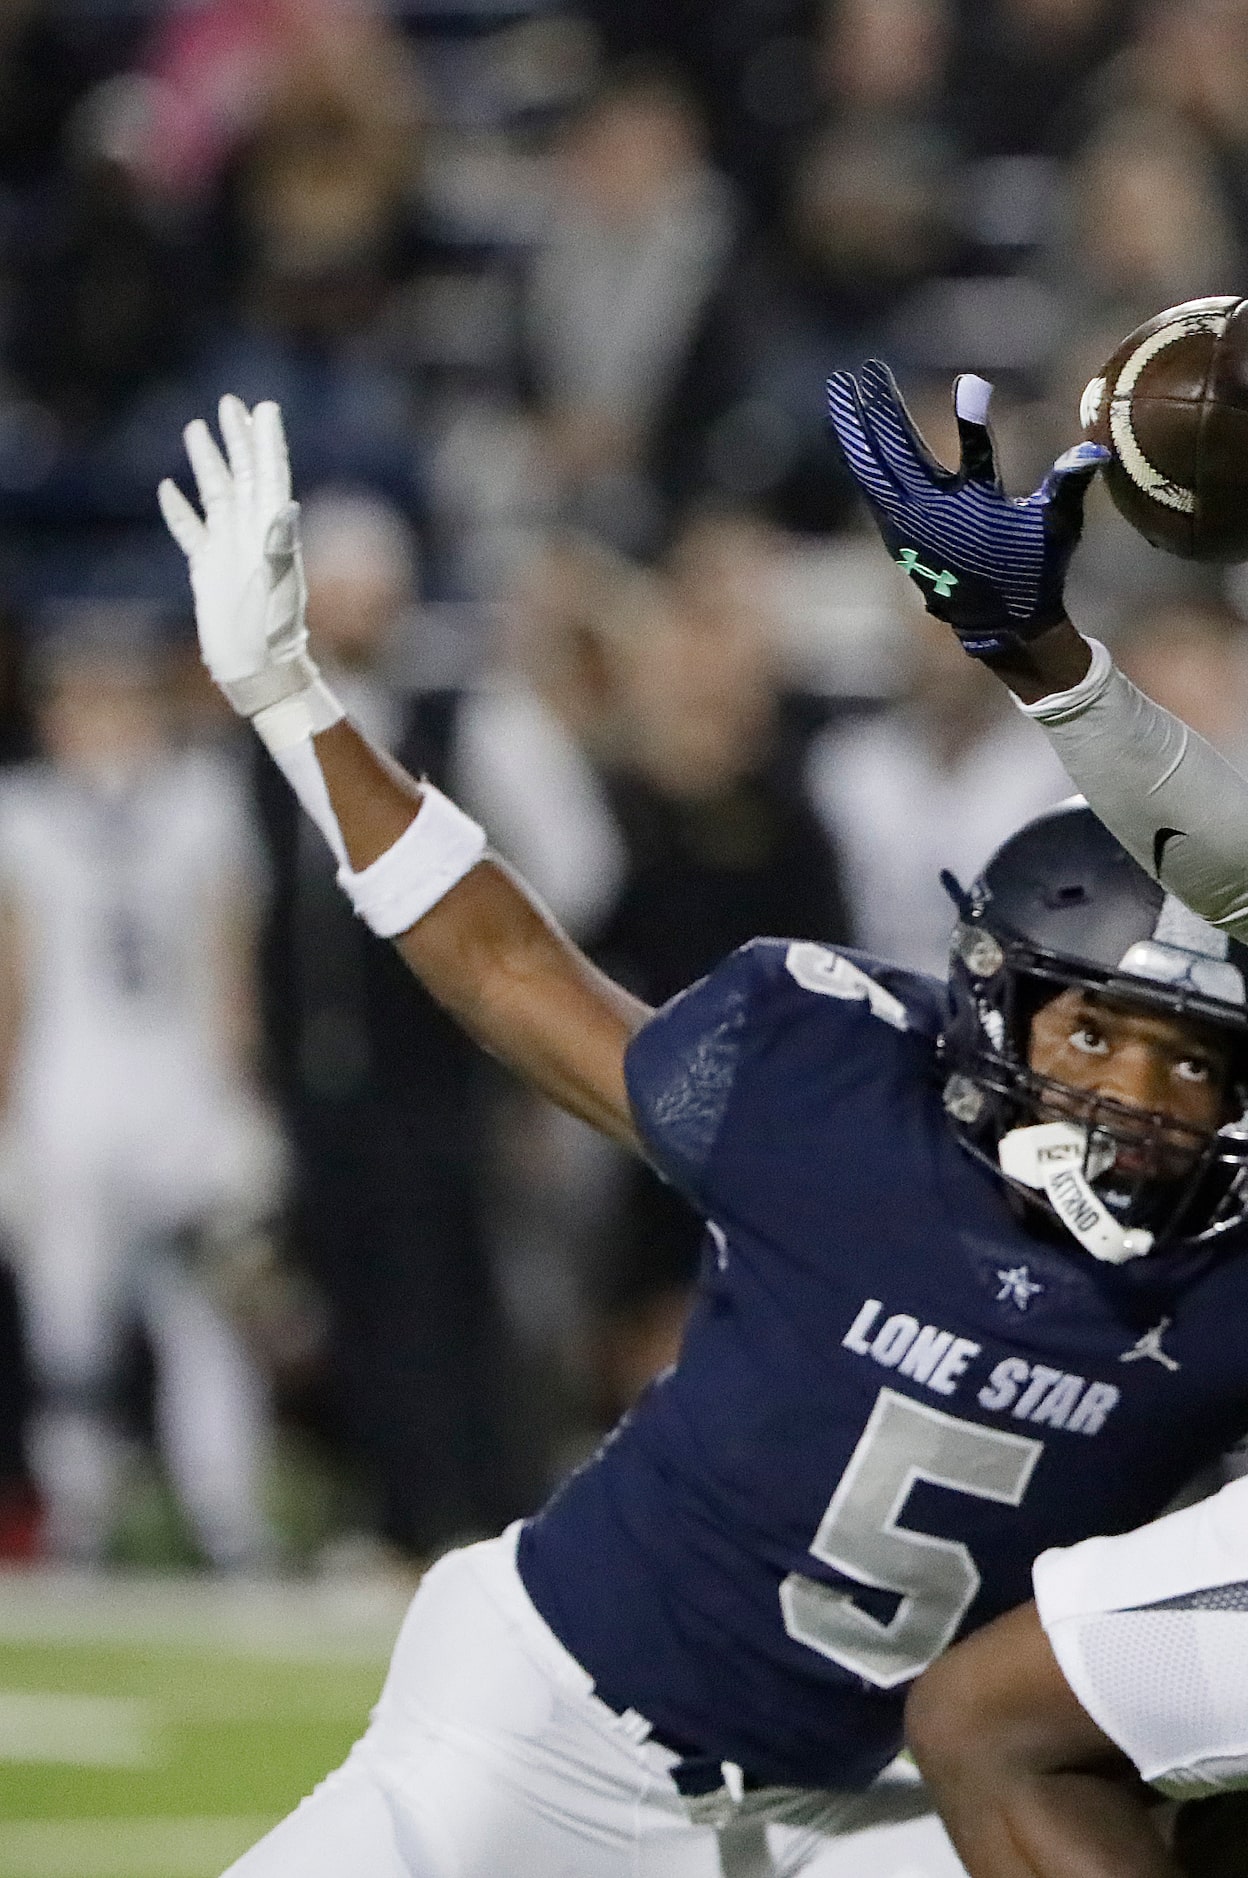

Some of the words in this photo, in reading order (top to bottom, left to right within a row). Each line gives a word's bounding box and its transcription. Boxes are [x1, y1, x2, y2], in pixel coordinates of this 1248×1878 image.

[841, 1299, 981, 1396] LONE
[978, 1356, 1120, 1436] STAR
[779, 1386, 1044, 1690] 5
